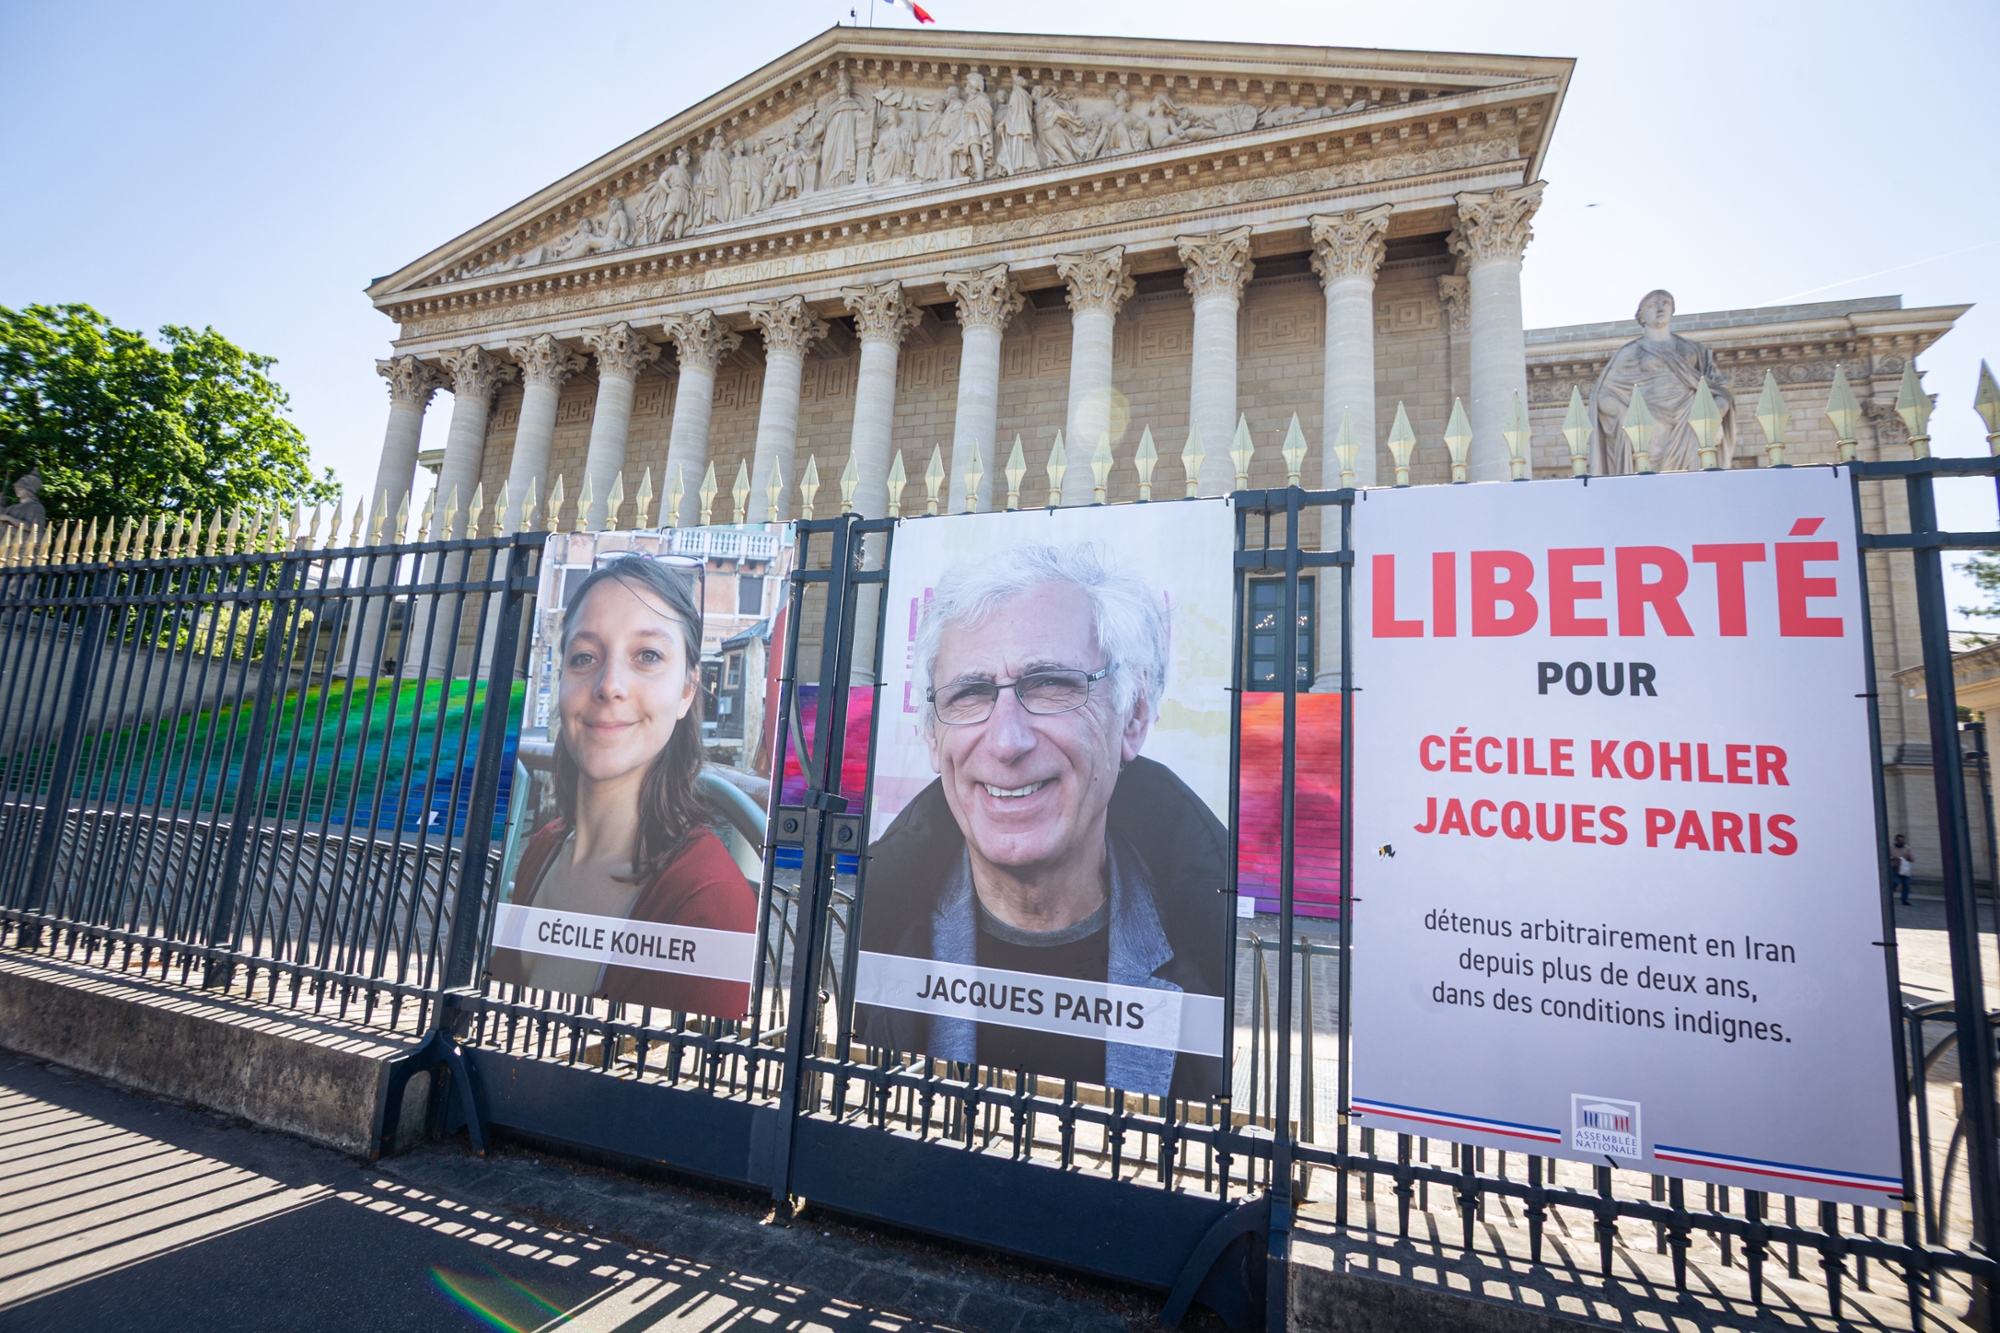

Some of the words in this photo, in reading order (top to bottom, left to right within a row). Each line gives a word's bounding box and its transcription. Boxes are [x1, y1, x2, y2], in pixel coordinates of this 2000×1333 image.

[705, 252, 828, 290] ASSEMBLÉE
[843, 229, 972, 267] NATIONALE
[1372, 517, 1844, 638] LIBERTÉ
[1538, 661, 1658, 696] POUR
[1420, 727, 1575, 777] CÉCILE
[1591, 740, 1790, 786] KOHLER
[1414, 797, 1628, 845] JACQUES
[1646, 808, 1798, 856] PARIS
[538, 918, 604, 950] CÉCILE
[611, 931, 696, 963] KOHLER
[1424, 909, 1512, 938] détenus
[1520, 919, 1697, 955] arbitrairement
[1706, 938, 1735, 958] en
[1745, 935, 1796, 964] Iran
[916, 973, 1044, 1016] JACQUES
[1054, 992, 1144, 1030] PARIS
[1459, 947, 1534, 978] depuis
[1542, 957, 1592, 984] plus
[1600, 962, 1629, 987] de
[1637, 966, 1697, 994] deux
[1705, 977, 1758, 1003] ans,
[1432, 981, 1485, 1008] dans
[1493, 987, 1532, 1014] des
[1541, 997, 1666, 1029] conditions
[1674, 1006, 1792, 1044] indignes.
[1576, 1130, 1637, 1147] ASSEMBLÉE
[1576, 1139, 1638, 1156] NATIONALE
